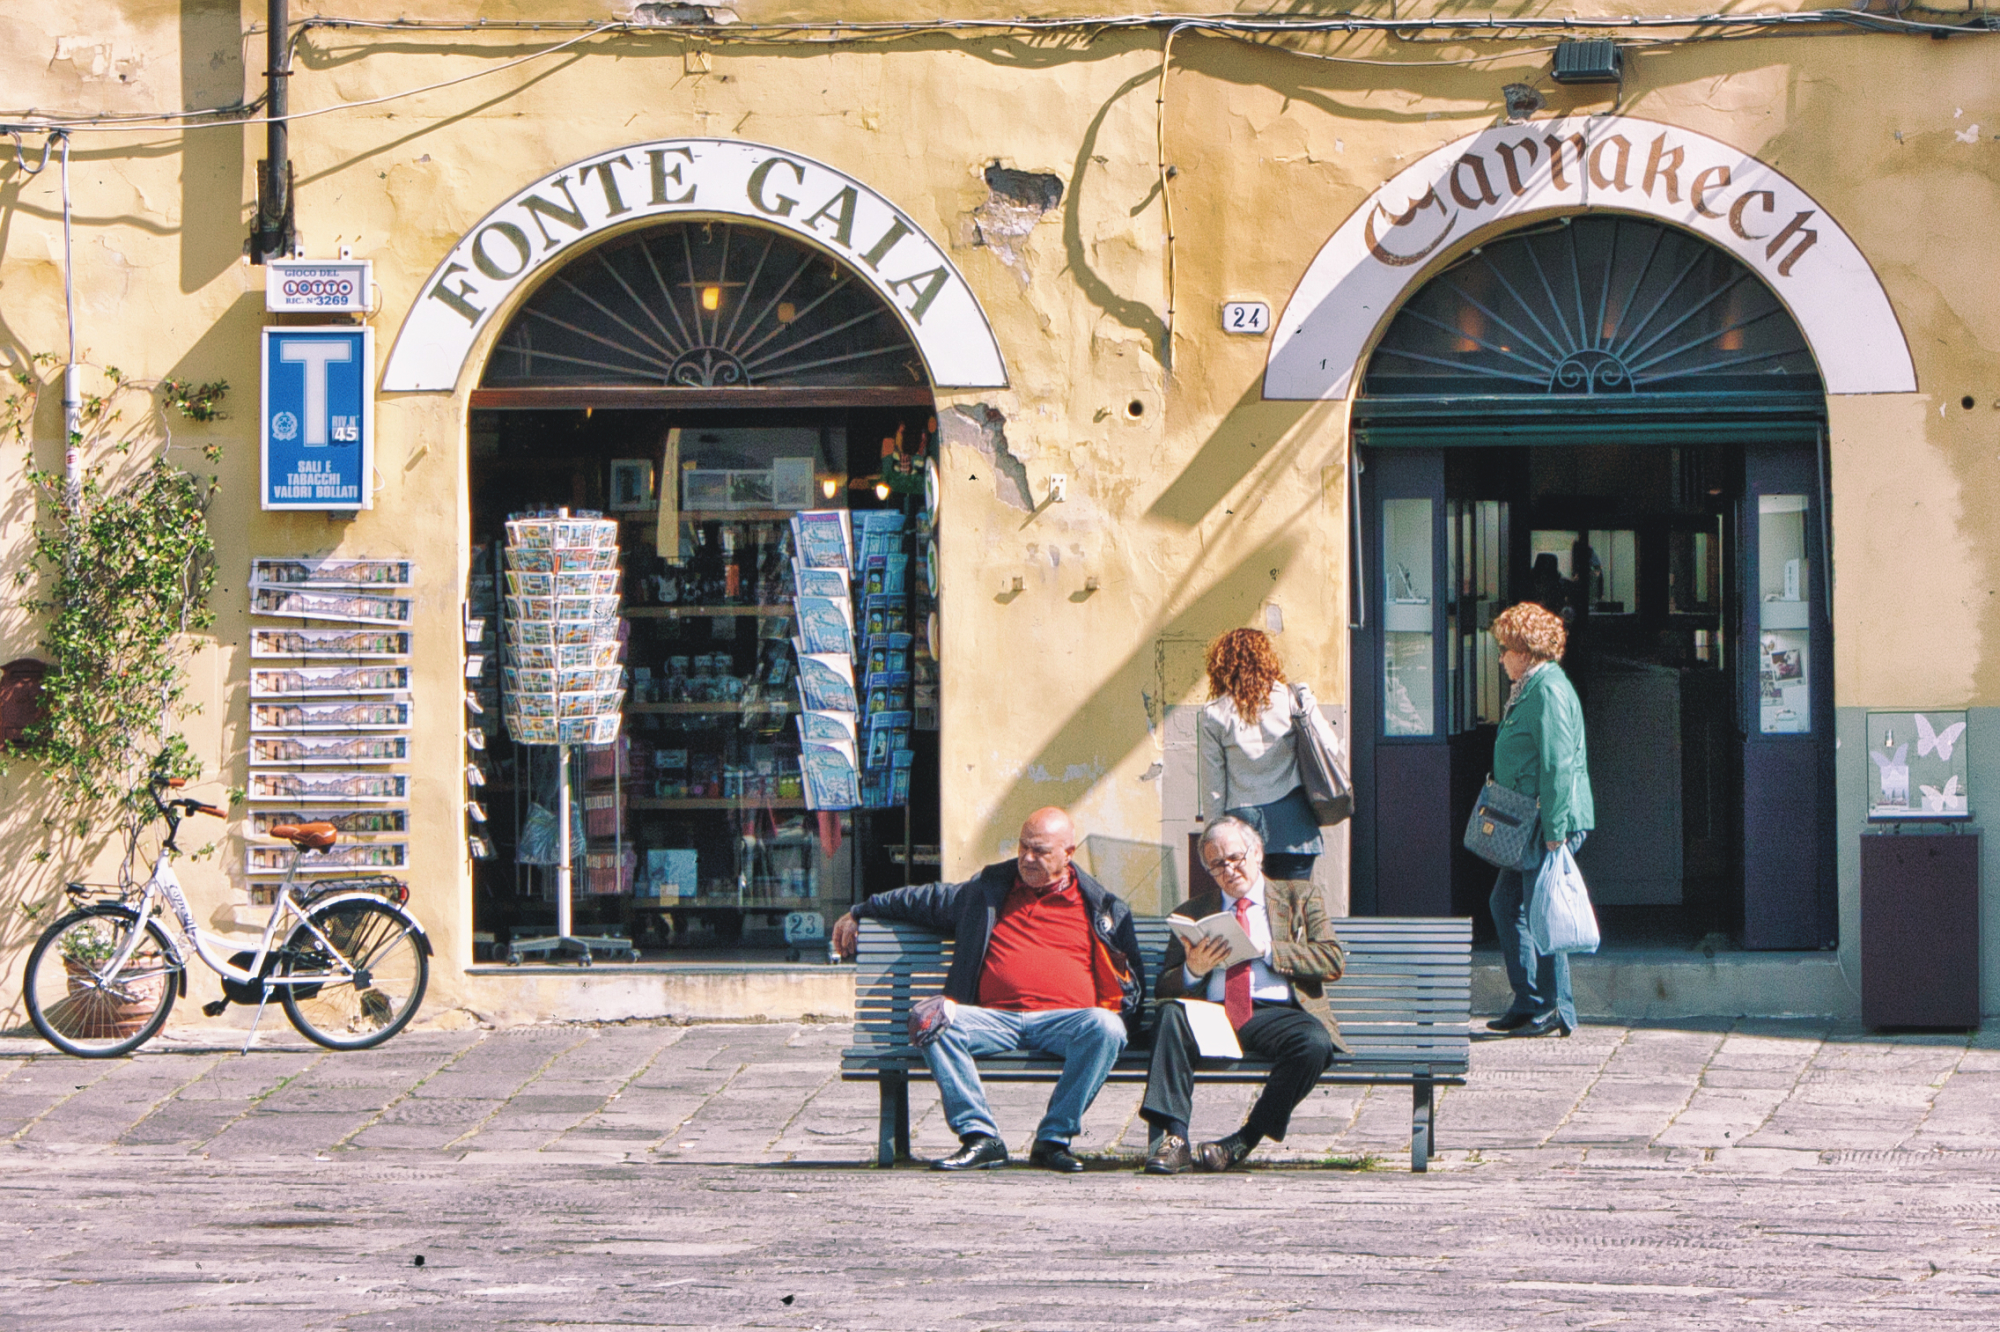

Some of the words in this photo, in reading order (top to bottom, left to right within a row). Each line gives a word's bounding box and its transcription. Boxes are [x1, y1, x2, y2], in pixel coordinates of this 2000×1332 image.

[428, 146, 699, 329] FONTE
[746, 156, 953, 326] GAIA
[284, 269, 317, 277] GIOCO
[319, 269, 340, 277] DEL
[283, 280, 353, 296] LOTTO
[1233, 306, 1260, 328] 24
[279, 340, 352, 447] T
[334, 427, 357, 441] 45
[297, 460, 321, 473] SALI
[325, 460, 332, 473] E
[287, 473, 341, 486] TABACCHI
[273, 485, 313, 499] VALORI
[316, 485, 358, 499] BOLLATI
[790, 914, 816, 935] 23
